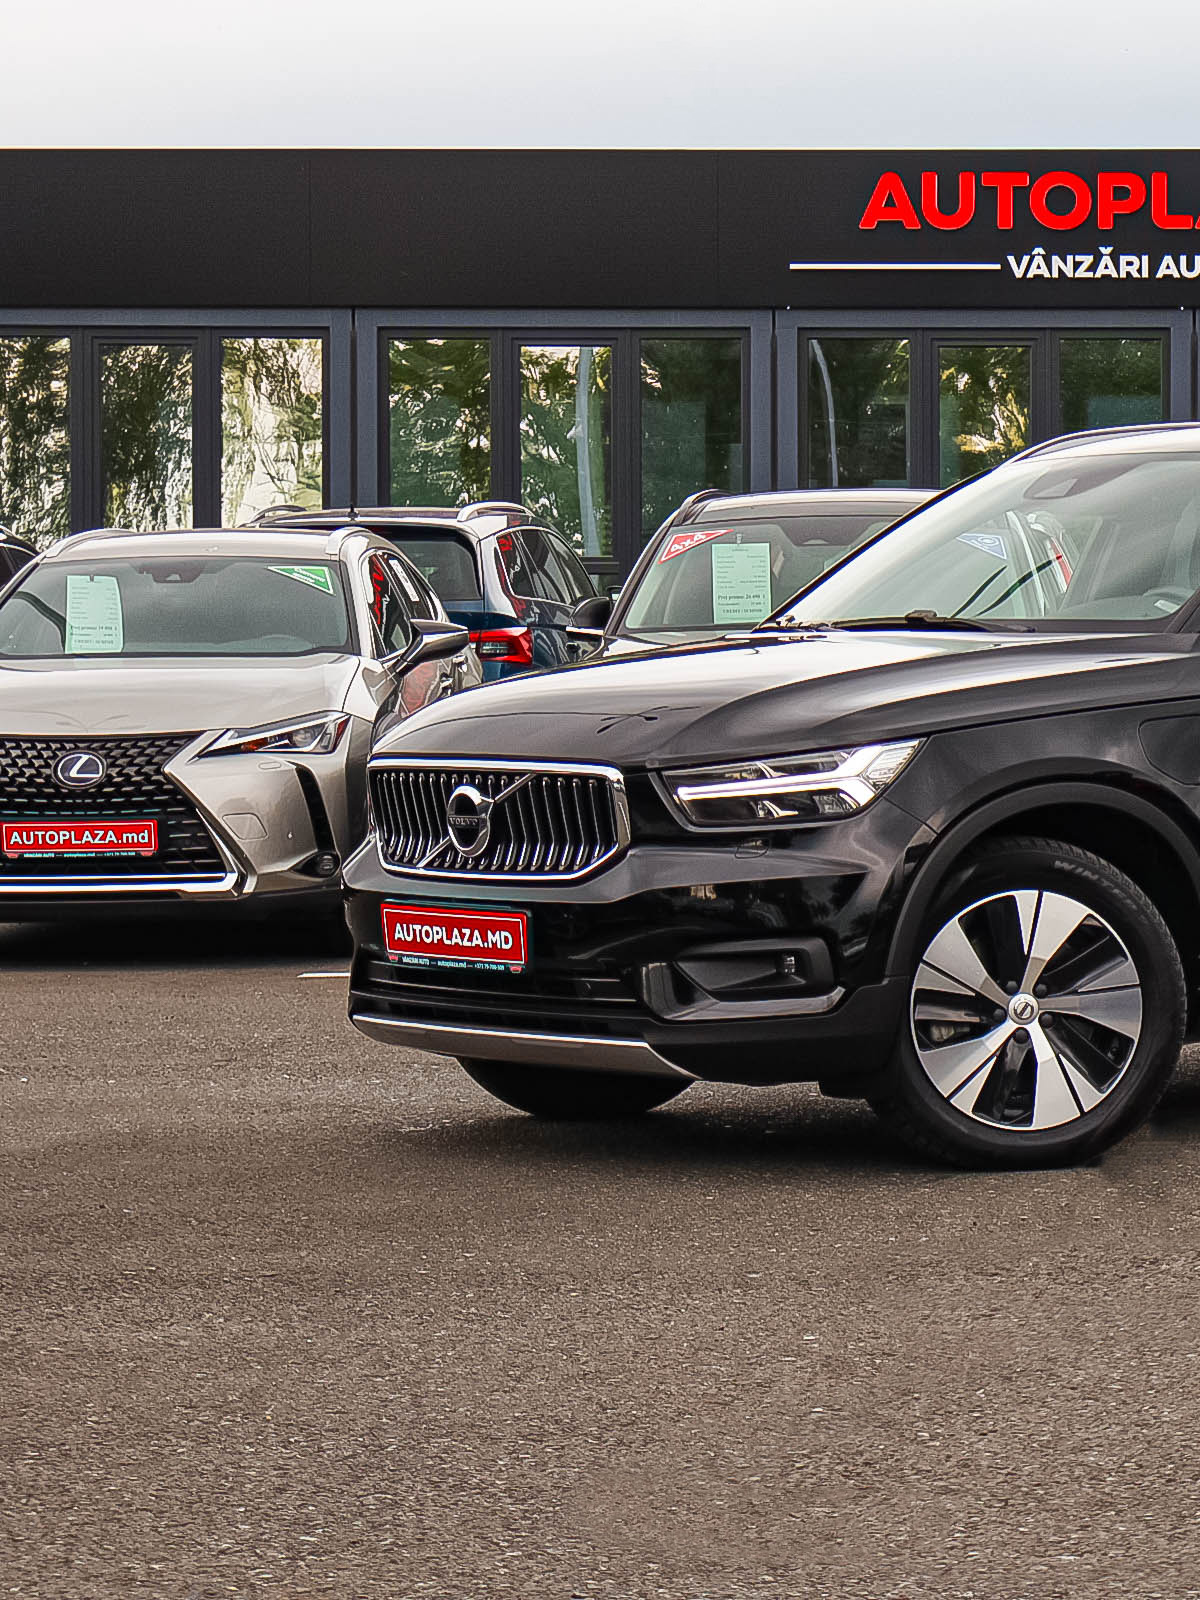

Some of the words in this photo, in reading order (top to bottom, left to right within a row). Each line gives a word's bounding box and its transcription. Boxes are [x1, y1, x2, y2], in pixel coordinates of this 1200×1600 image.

[1006, 246, 1150, 280] VÂNZĂRI
[9, 829, 149, 845] AUTOPLAZA.md
[394, 923, 513, 949] AUTOPLAZA.MD
